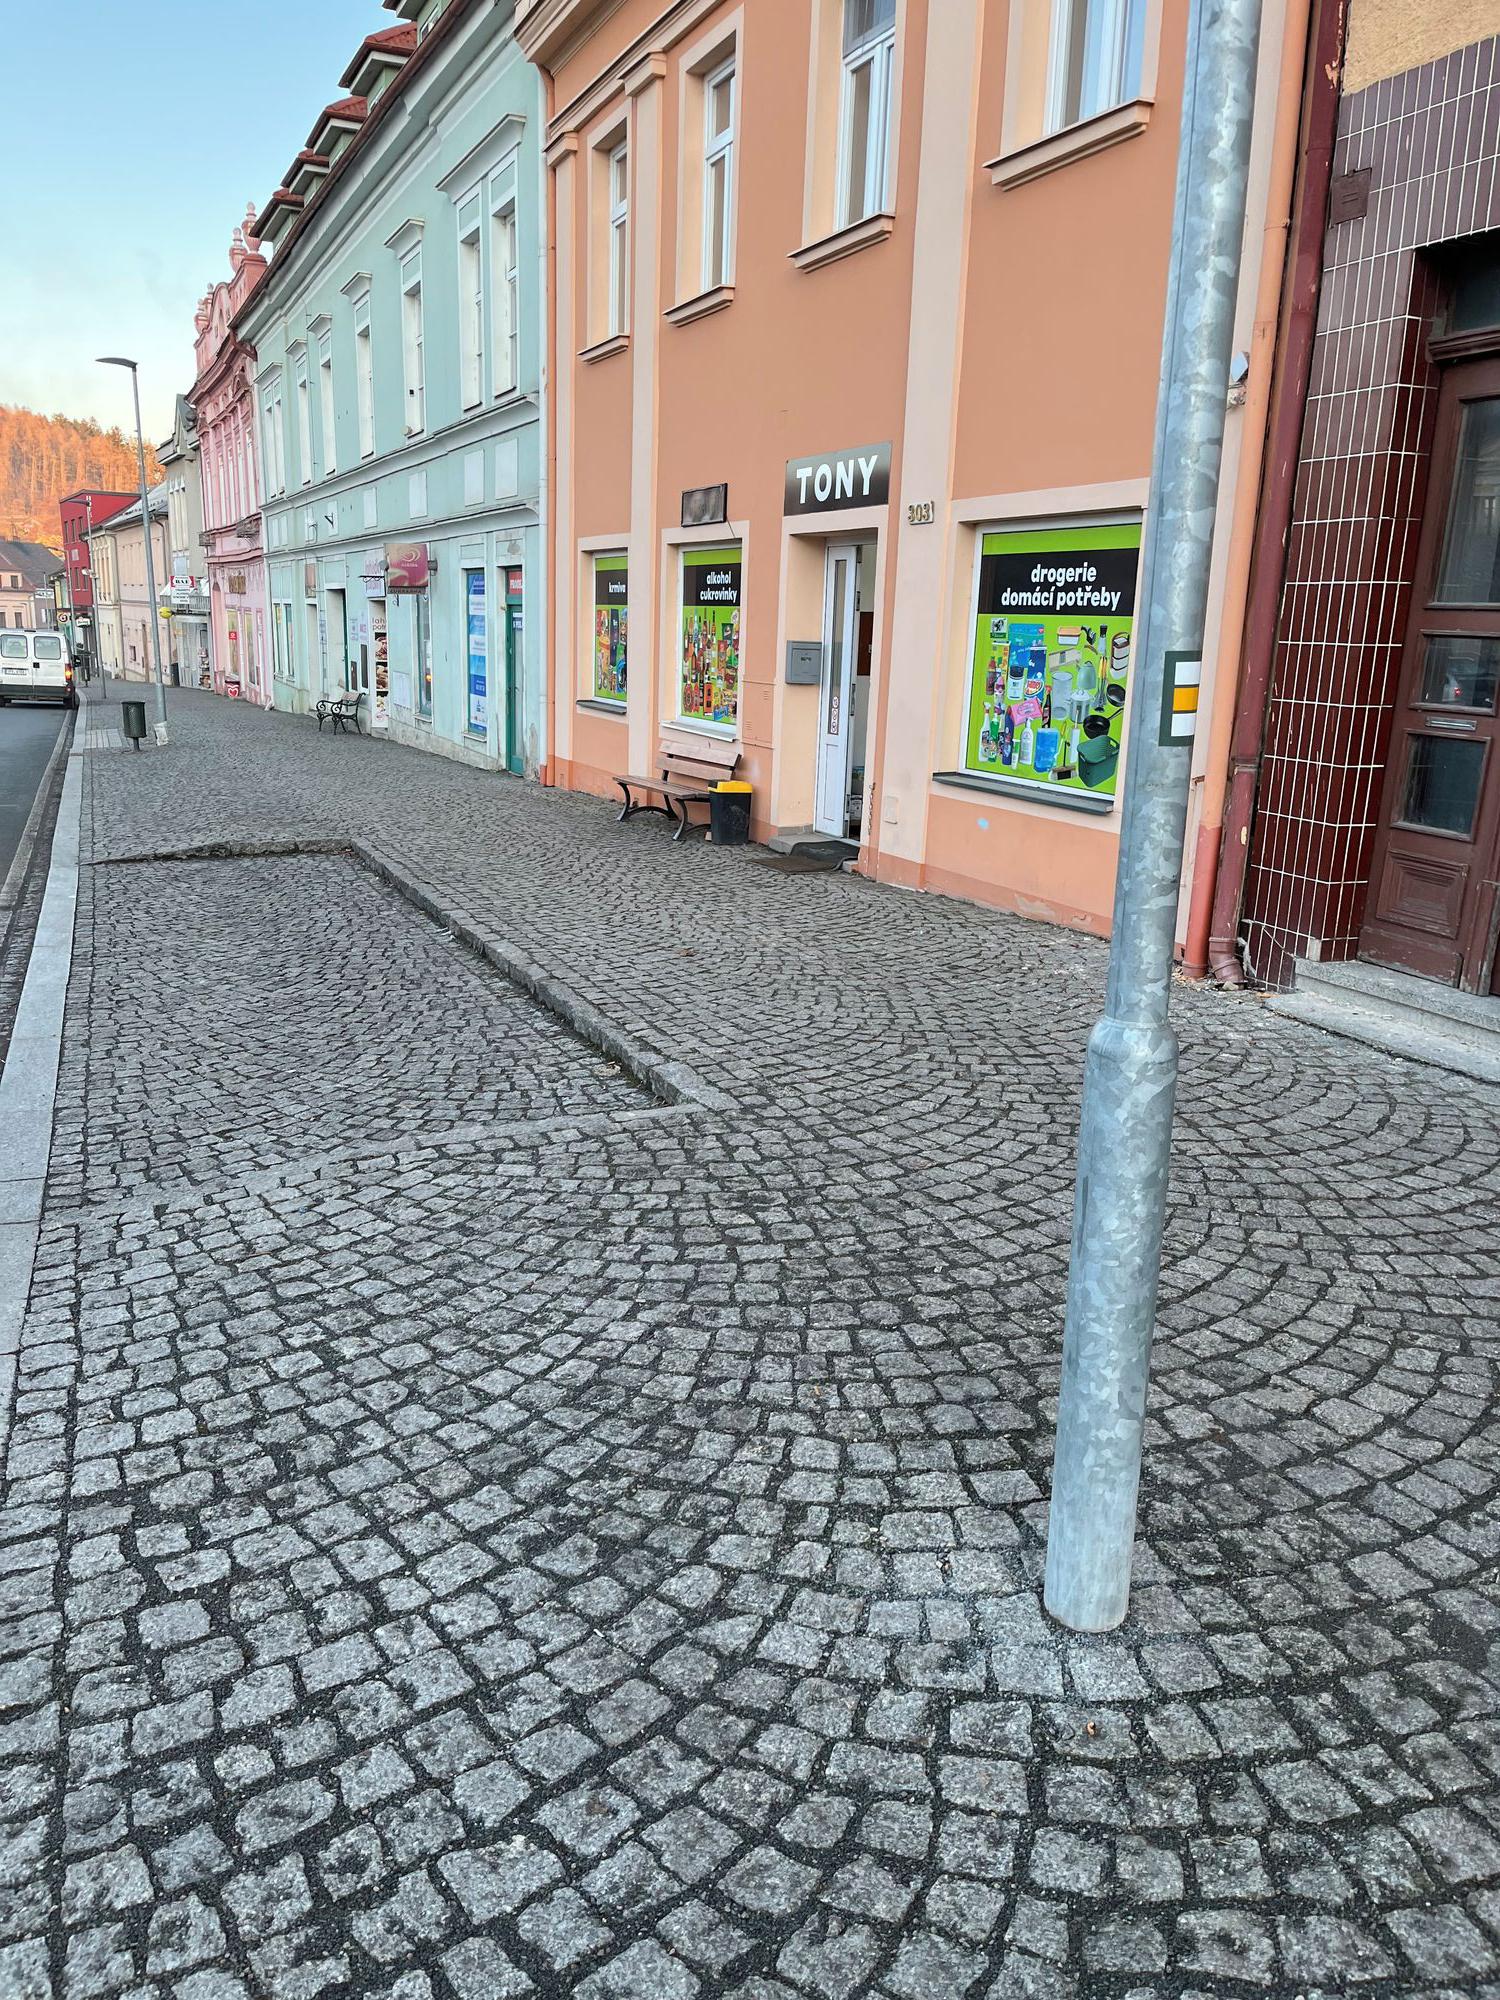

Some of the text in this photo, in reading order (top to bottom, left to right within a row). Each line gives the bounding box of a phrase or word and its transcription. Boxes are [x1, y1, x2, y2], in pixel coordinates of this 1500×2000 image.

[796, 454, 879, 505] TONY
[907, 503, 930, 523] 303
[706, 570, 732, 585] alkohol
[1031, 561, 1097, 587] drogerie
[608, 581, 627, 593] krmiva
[699, 587, 738, 604] cukrovinky
[1001, 585, 1122, 611] domácí potřeby
